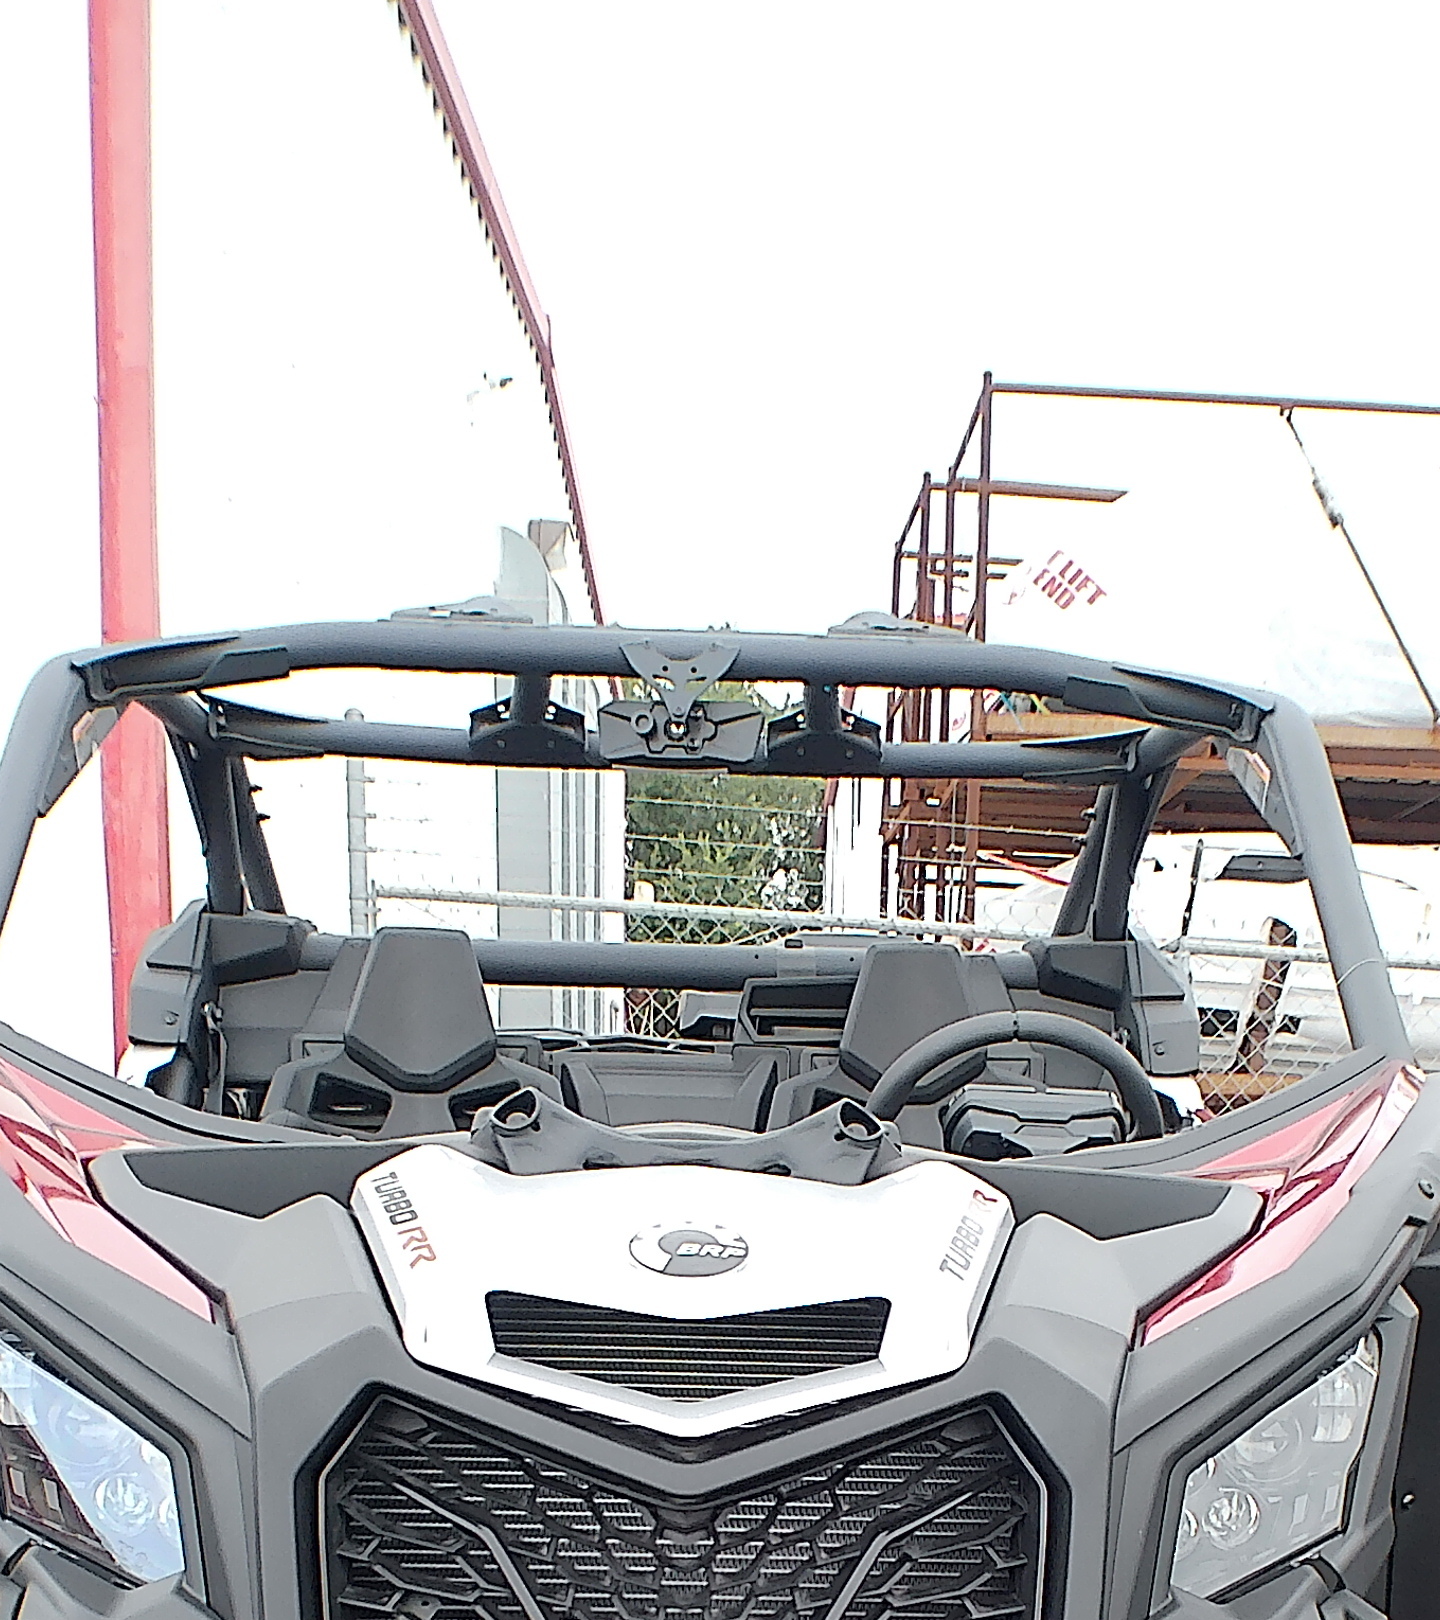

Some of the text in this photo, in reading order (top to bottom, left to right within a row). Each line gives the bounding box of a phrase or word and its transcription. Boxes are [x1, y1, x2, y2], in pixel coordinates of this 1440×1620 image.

[1032, 567, 1076, 610] END
[1058, 559, 1108, 606] LIFT
[370, 1171, 437, 1270] TURBO RR
[676, 1241, 748, 1260] BRP
[939, 1215, 984, 1281] TURBO
